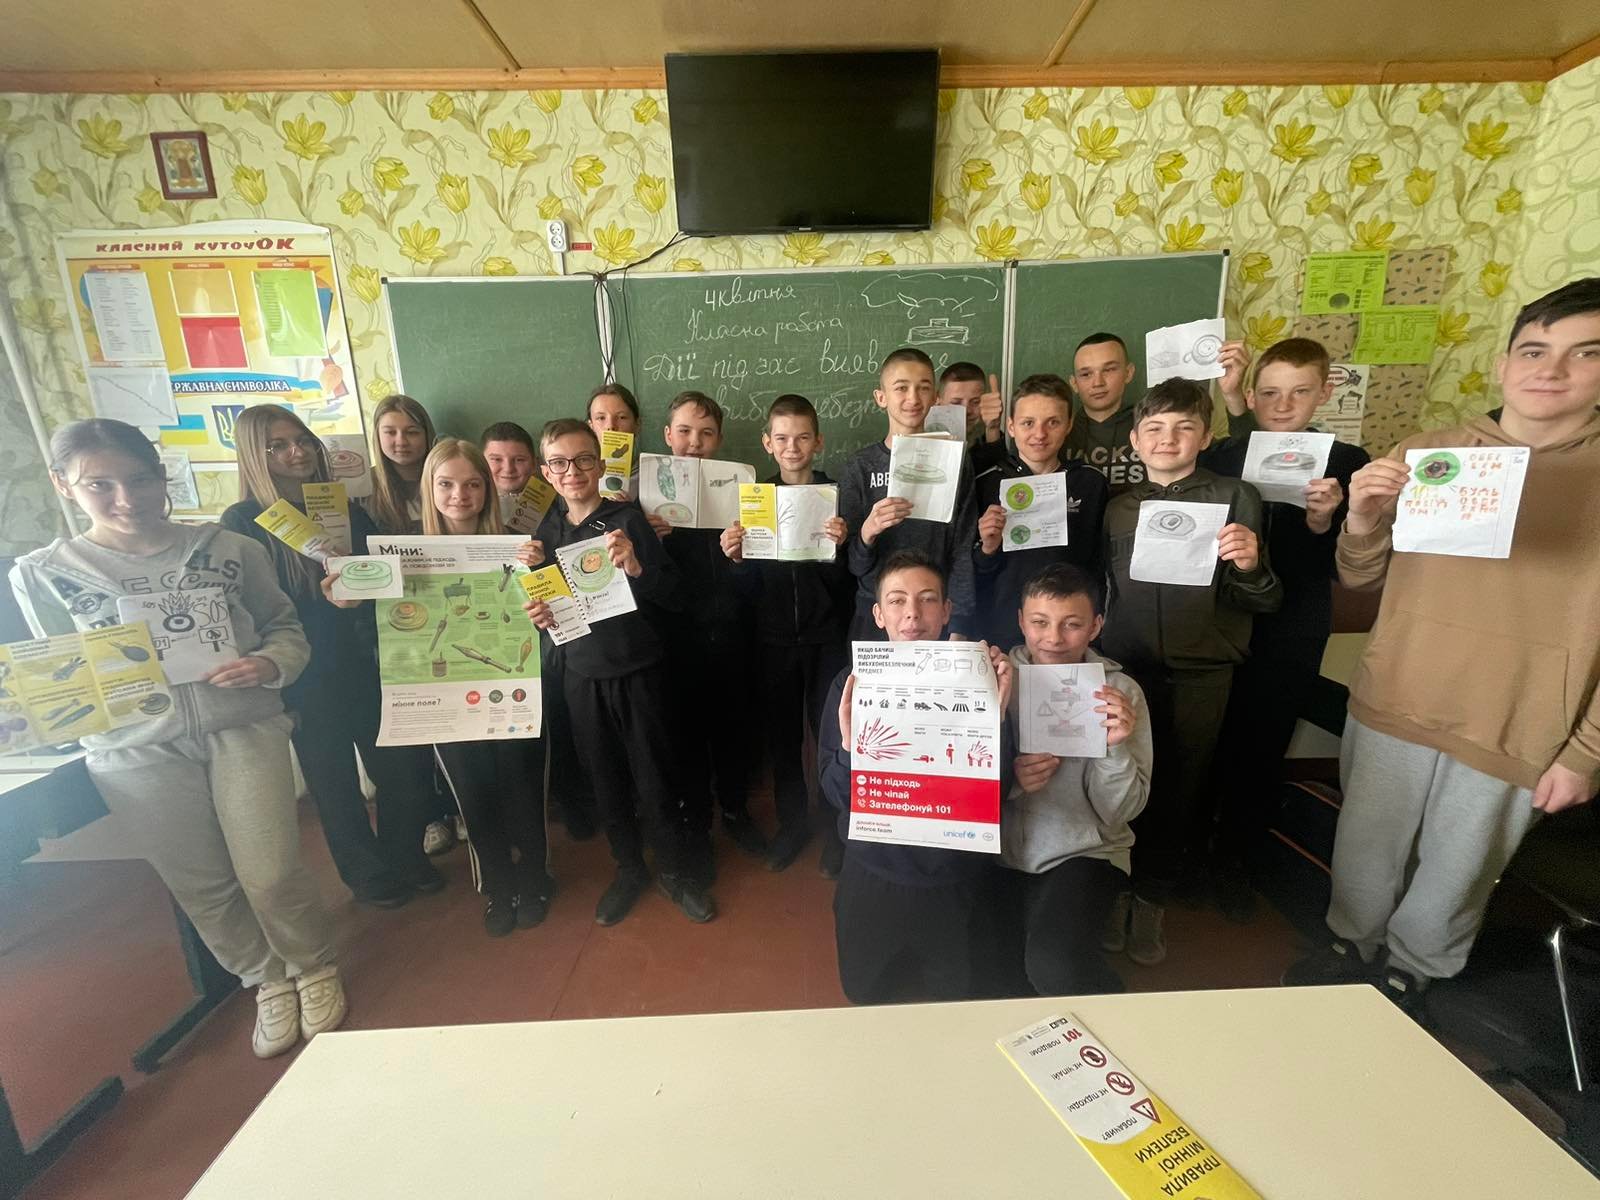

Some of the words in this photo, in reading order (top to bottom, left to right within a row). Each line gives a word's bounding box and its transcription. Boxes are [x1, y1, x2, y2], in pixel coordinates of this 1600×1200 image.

[712, 354, 748, 391] під
[869, 776, 882, 785] Не
[884, 778, 921, 788] підходь
[869, 789, 882, 797] Не
[884, 790, 910, 799] чіпай
[869, 800, 933, 814] Зателефонуй
[935, 805, 951, 814] 101
[944, 830, 967, 839] unicef
[1062, 1028, 1083, 1043] 101
[1098, 1087, 1110, 1097] НЕ
[1102, 1116, 1138, 1140] ПОБАЧИВ?
[1134, 1126, 1190, 1163] БЕЗПЕКИ
[1158, 1140, 1205, 1177] МІННОЇ
[1161, 1155, 1221, 1196] ПРАВИЛА
